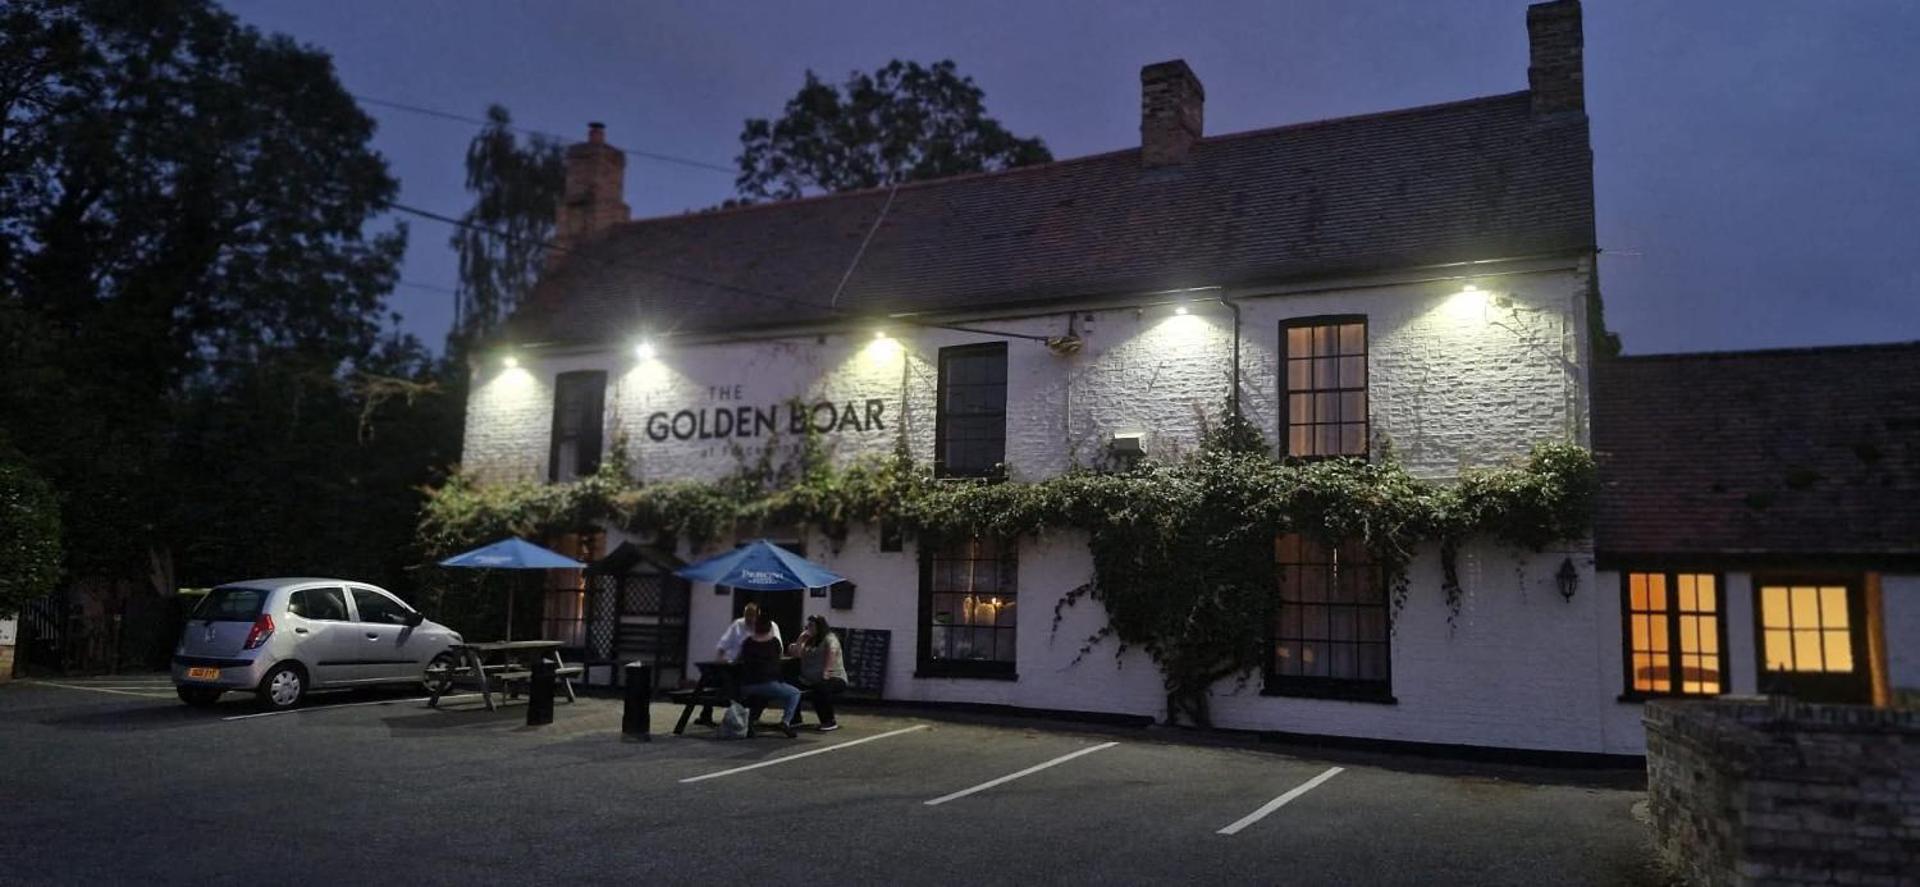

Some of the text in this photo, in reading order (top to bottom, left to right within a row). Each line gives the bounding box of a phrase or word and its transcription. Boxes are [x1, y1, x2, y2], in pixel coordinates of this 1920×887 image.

[709, 385, 743, 401] THE
[647, 399, 885, 441] GOLDEN BOAR
